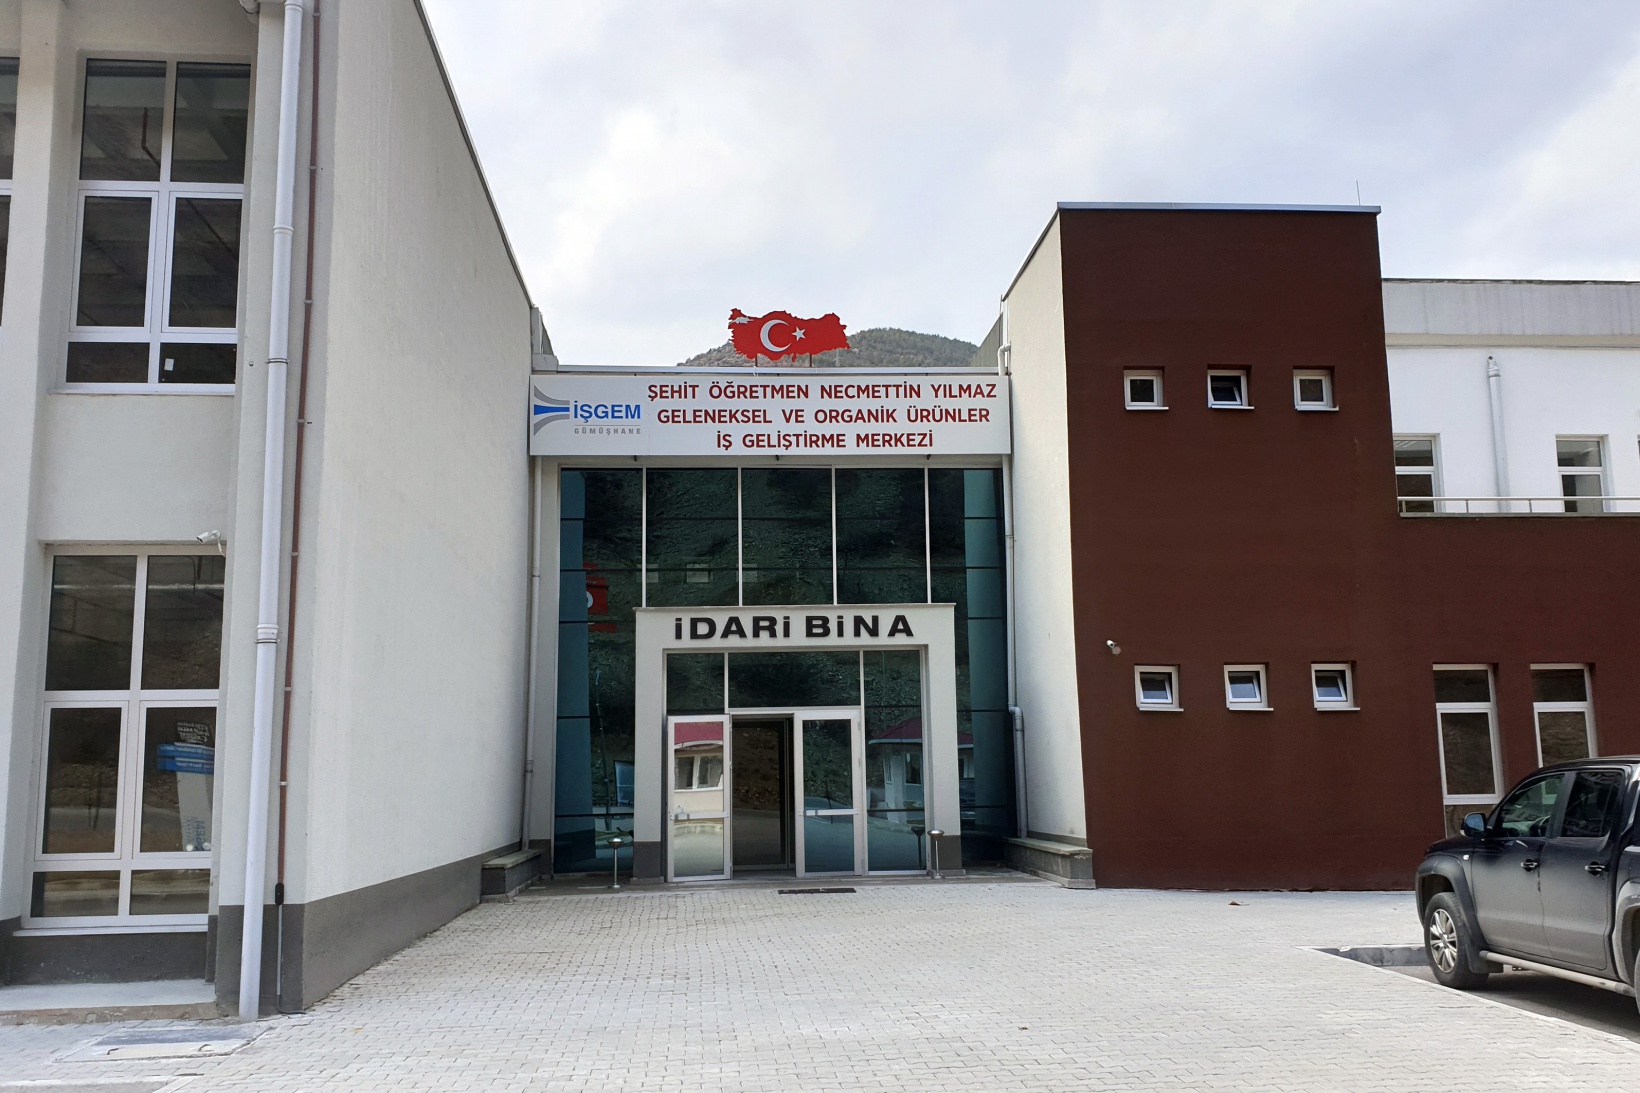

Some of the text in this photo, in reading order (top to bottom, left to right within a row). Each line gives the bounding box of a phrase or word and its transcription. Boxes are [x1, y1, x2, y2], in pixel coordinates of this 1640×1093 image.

[647, 381, 997, 402] ŞEHİT ÖĞRETMEN NECMETTİN YILMAZ
[573, 400, 641, 423] İŞGEM
[656, 405, 991, 424] GELENEKSEL VE ORGANİK ÜRÜNLER
[574, 426, 641, 436] GÜMÜŞHANE
[716, 429, 934, 451] İŞ GELİŞTİRME MERKEZİ
